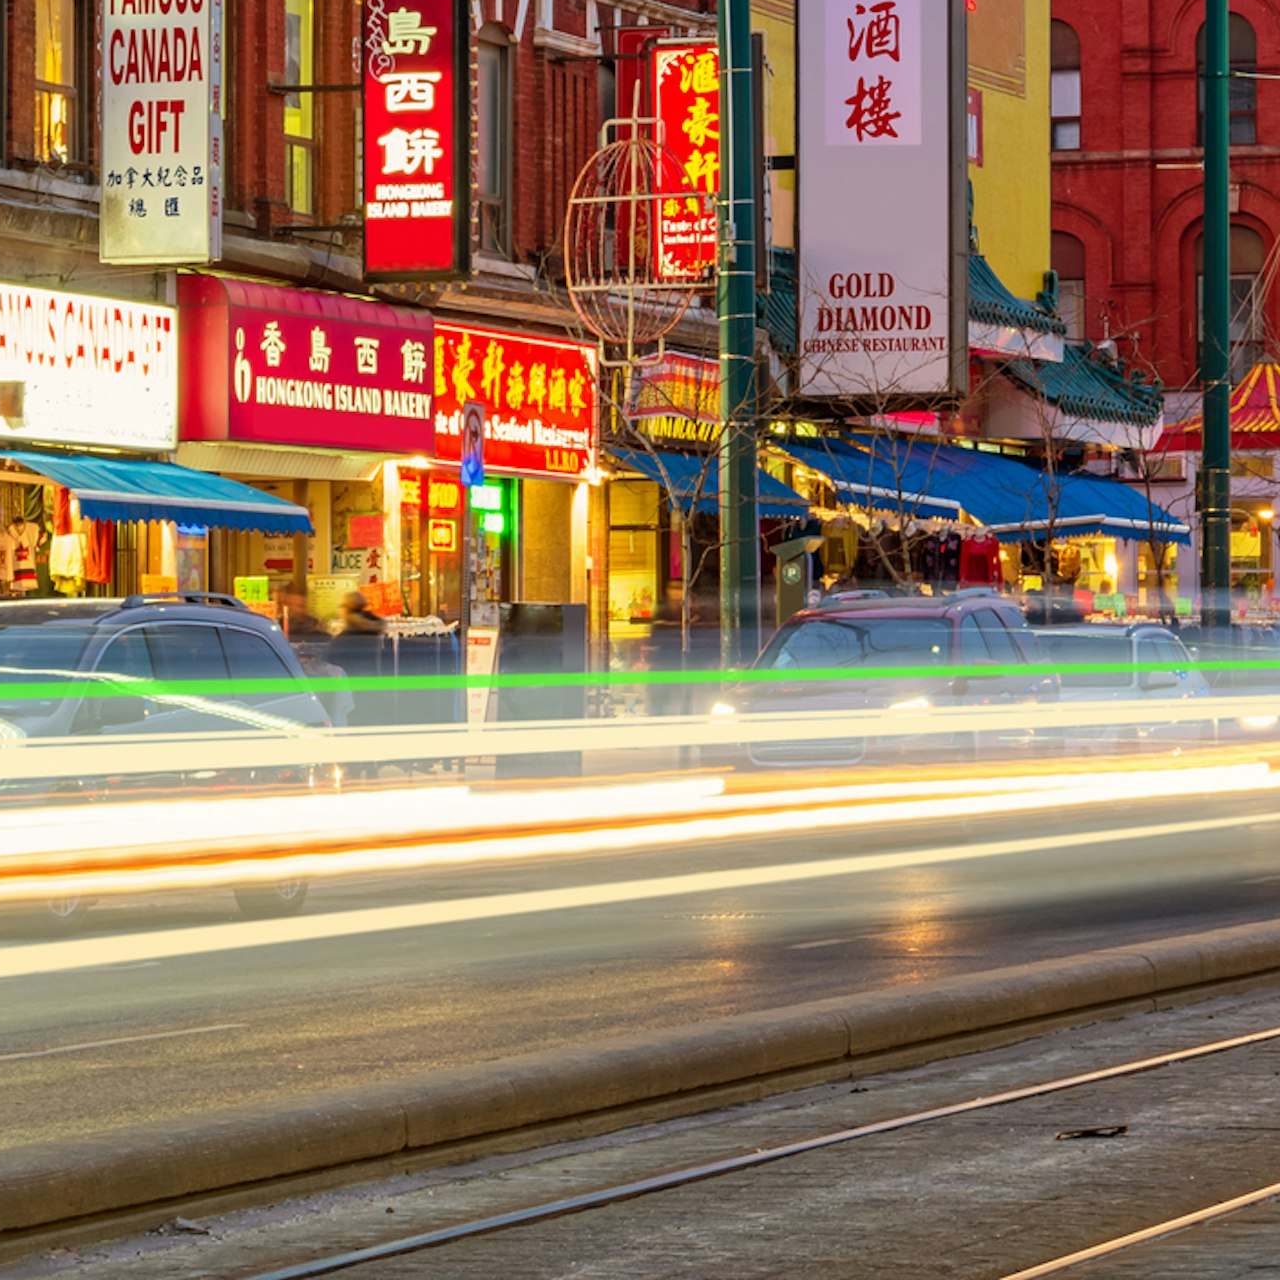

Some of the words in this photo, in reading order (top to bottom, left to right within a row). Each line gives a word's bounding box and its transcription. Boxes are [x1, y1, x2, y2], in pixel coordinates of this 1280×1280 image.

[109, 26, 204, 87] CANADA
[128, 99, 186, 156] GIFT
[375, 183, 444, 201] HONGKONG
[367, 202, 409, 218] ISLAND
[411, 200, 453, 217] BAKERY
[828, 273, 895, 299] GOLD
[817, 305, 932, 332] DIAMOND
[259, 320, 428, 384] 香島西餅
[804, 337, 859, 354] CHINESE
[863, 336, 946, 352] RESTAURANT
[256, 376, 333, 410] HONGKONG
[335, 385, 382, 414] ISLAND
[384, 389, 432, 419] BAKERY
[332, 553, 363, 569] ALICE
